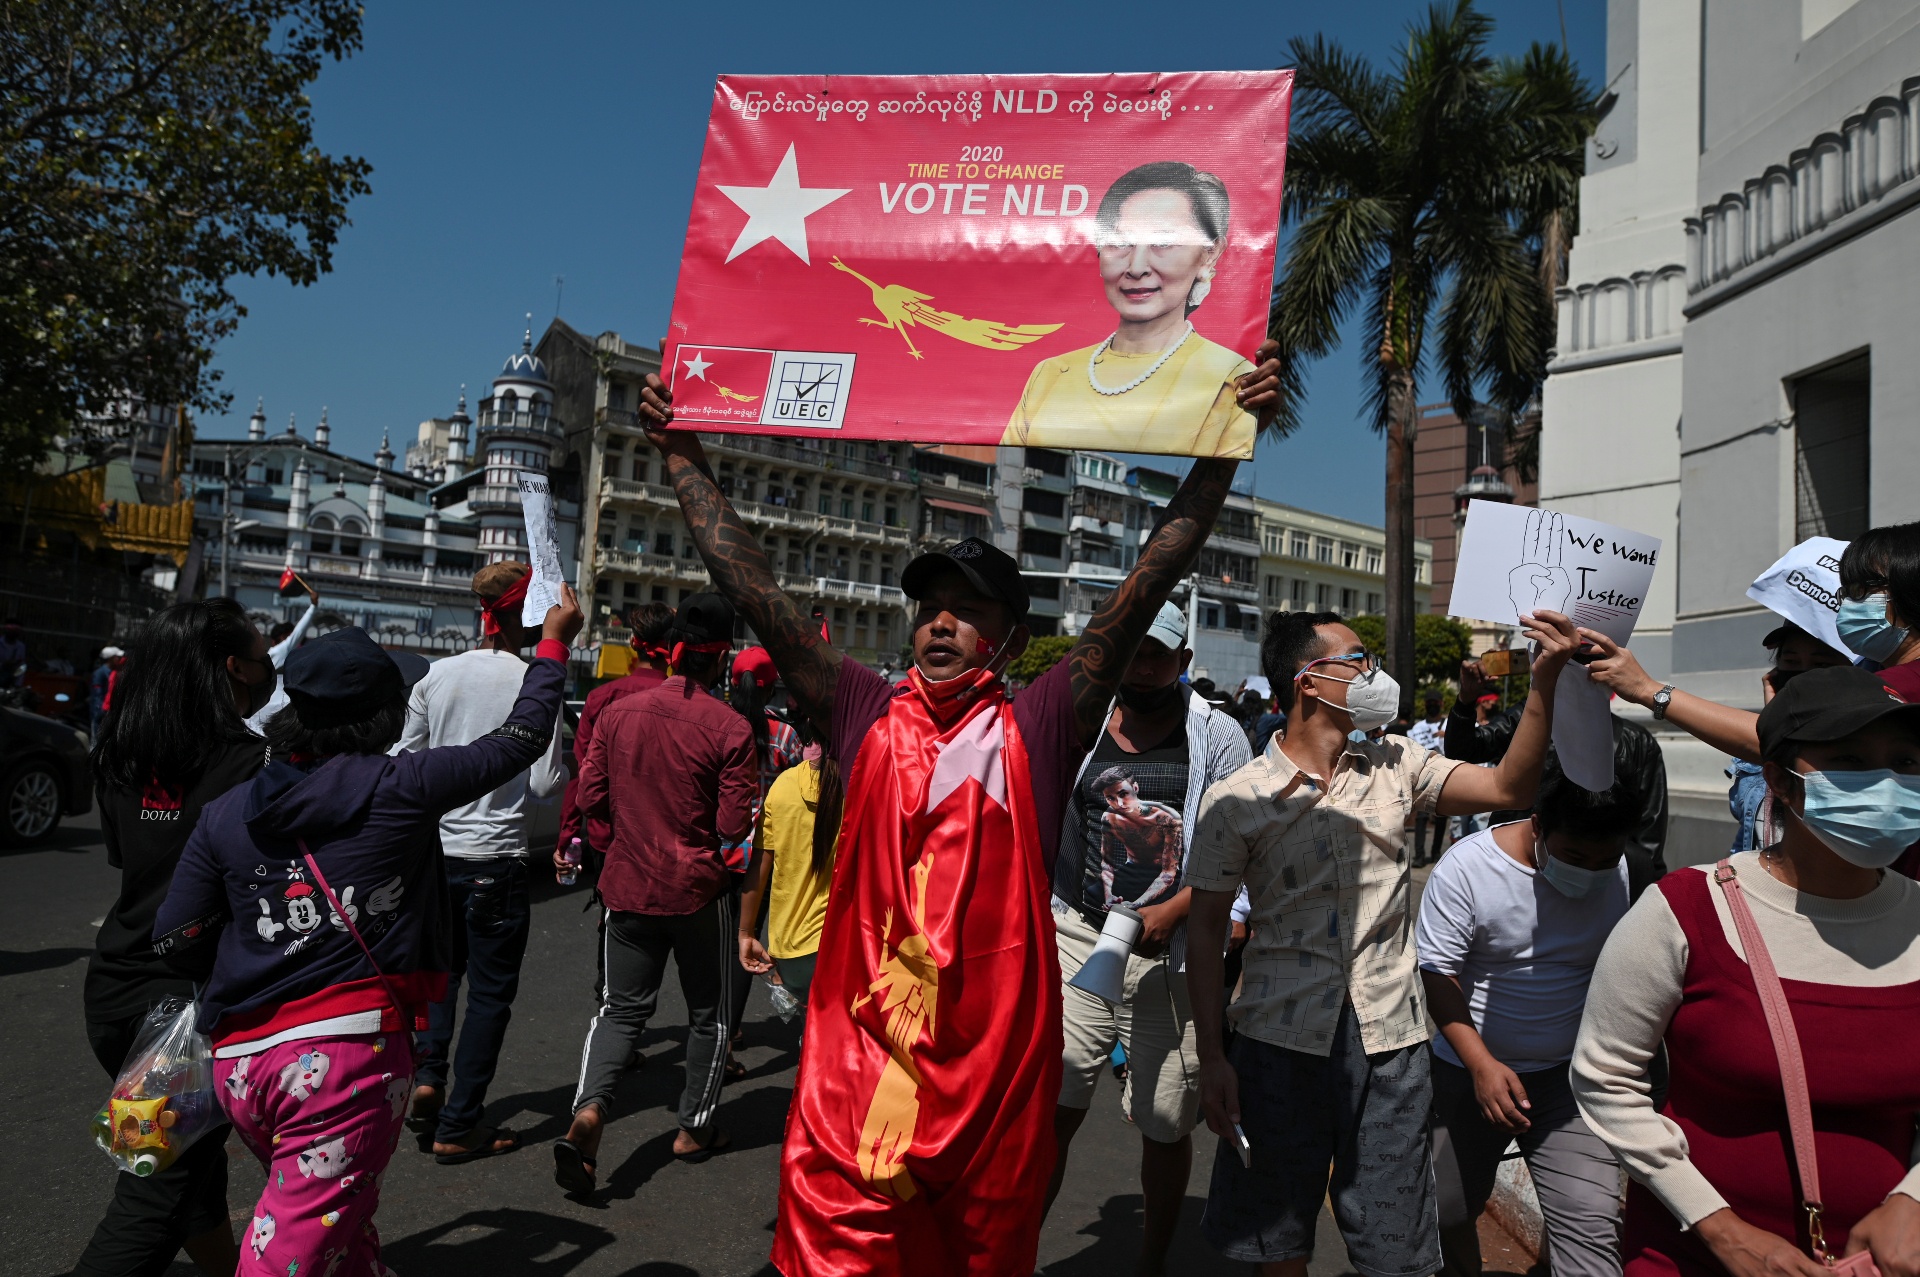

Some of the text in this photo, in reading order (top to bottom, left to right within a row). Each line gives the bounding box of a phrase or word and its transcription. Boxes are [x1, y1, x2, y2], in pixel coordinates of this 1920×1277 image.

[992, 89, 1058, 114] NLD
[1068, 90, 1094, 122] ကို
[959, 145, 1004, 162] 2020
[907, 163, 1064, 180] TIME TO CHANGE
[879, 182, 1089, 216] VOTE NLD
[1567, 528, 1657, 566] We Want
[1576, 566, 1639, 610] Justice
[140, 809, 180, 821] DOTA 2
[1374, 1074, 1398, 1083] FILA
[1394, 1103, 1415, 1115] FILA
[1373, 1121, 1394, 1130] FILA
[1378, 1153, 1403, 1163] FILA
[1397, 1185, 1418, 1195] FILA
[1374, 1200, 1397, 1209] FILA
[1380, 1233, 1405, 1243] FILA
